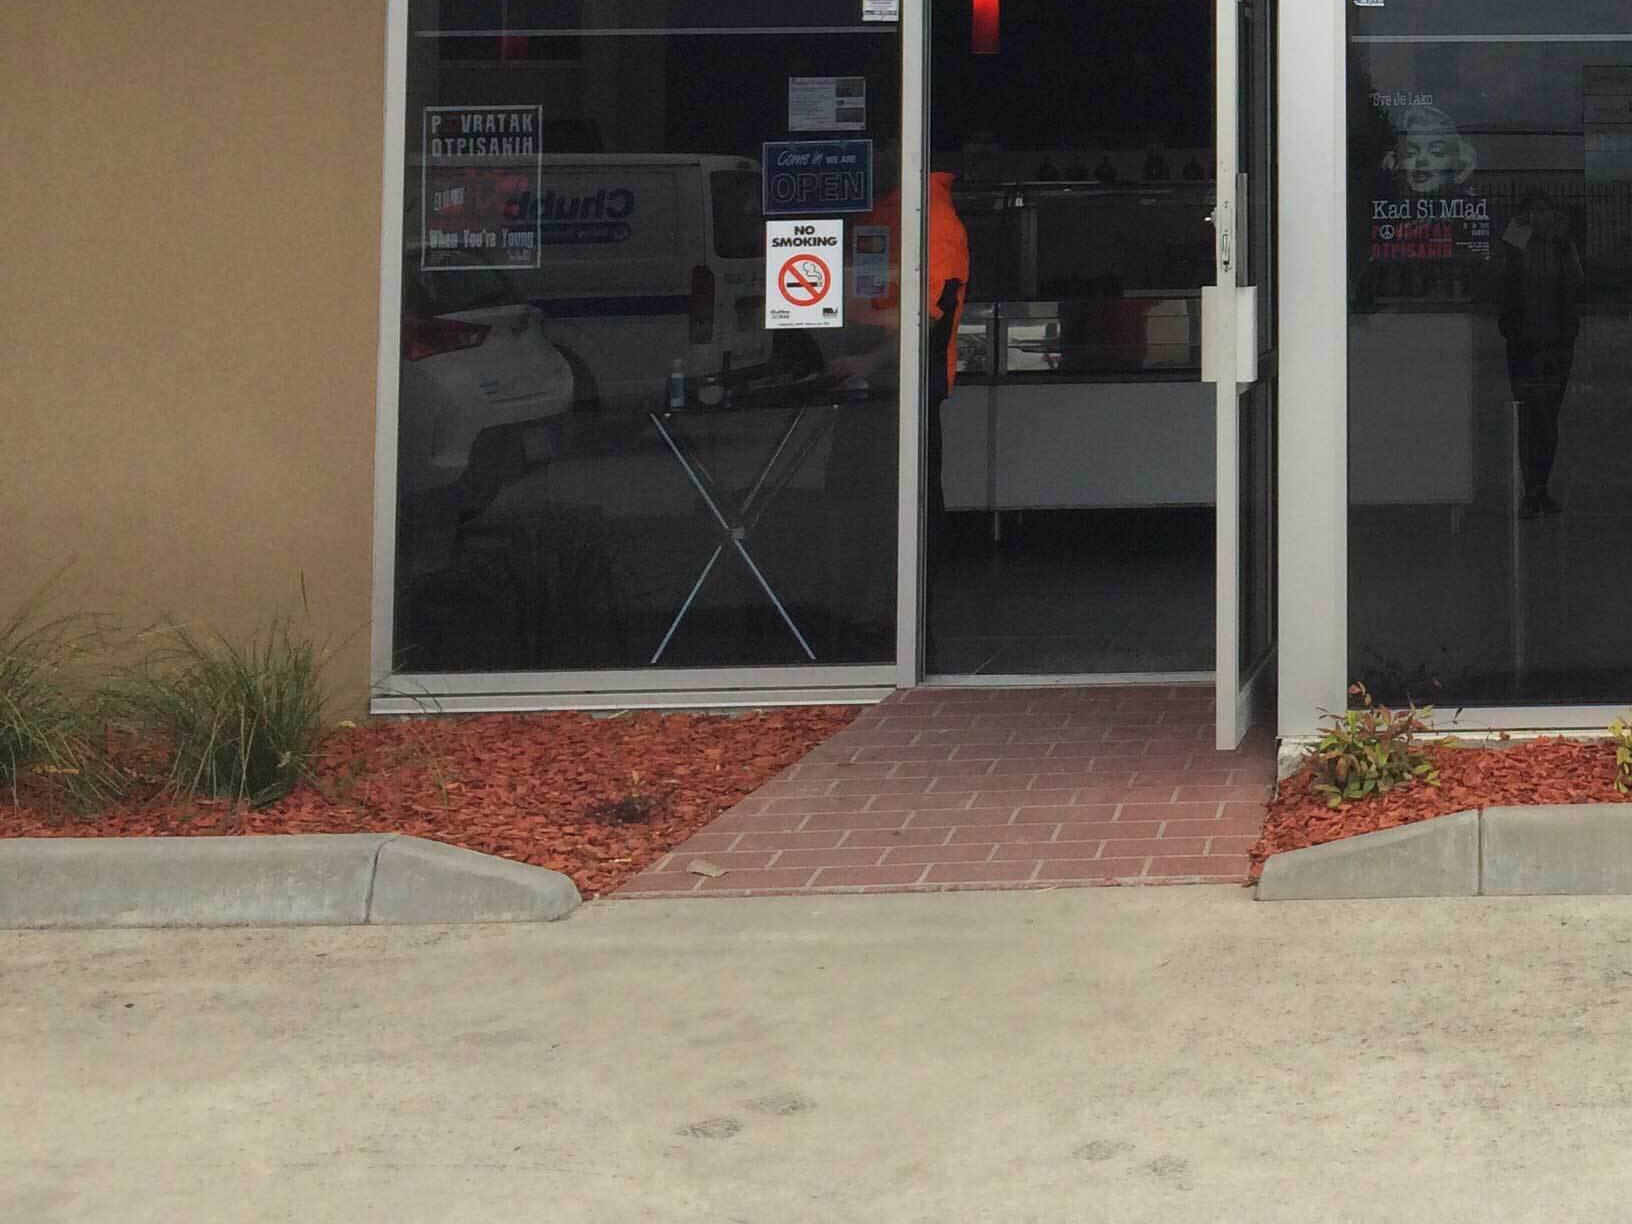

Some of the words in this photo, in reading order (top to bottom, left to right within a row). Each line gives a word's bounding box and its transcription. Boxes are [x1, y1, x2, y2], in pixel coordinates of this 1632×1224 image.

[771, 171, 864, 202] OPEN
[1372, 199, 1411, 219] Kad
[1417, 199, 1436, 219] Si
[1440, 198, 1489, 219] Mlad
[794, 225, 815, 235] NO
[772, 236, 837, 247] SMOKING
